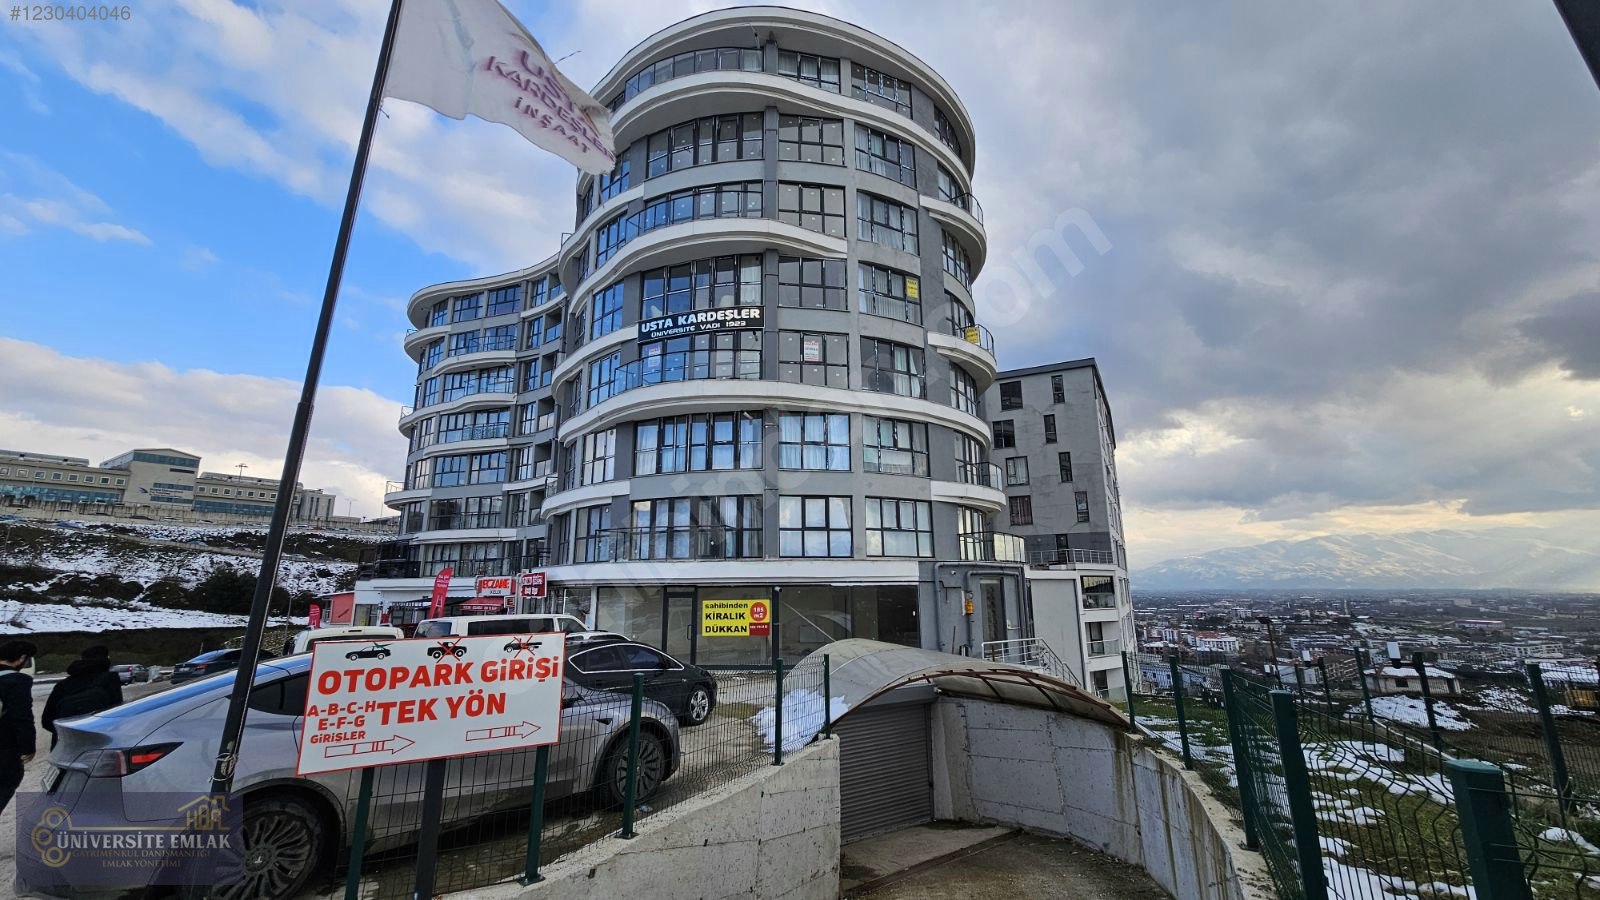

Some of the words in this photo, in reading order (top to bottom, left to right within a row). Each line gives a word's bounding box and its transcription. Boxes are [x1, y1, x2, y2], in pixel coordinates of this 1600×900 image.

[641, 318, 673, 333] USTA
[678, 308, 761, 326] KARDEŞLER
[726, 320, 746, 328] 1923
[705, 611, 746, 620] KİRALIK
[705, 624, 748, 633] DÜKKAN
[317, 661, 474, 695] OTOPARK
[377, 698, 439, 726] TEK
[446, 688, 506, 717] YÖN
[317, 715, 366, 731] E-F-G
